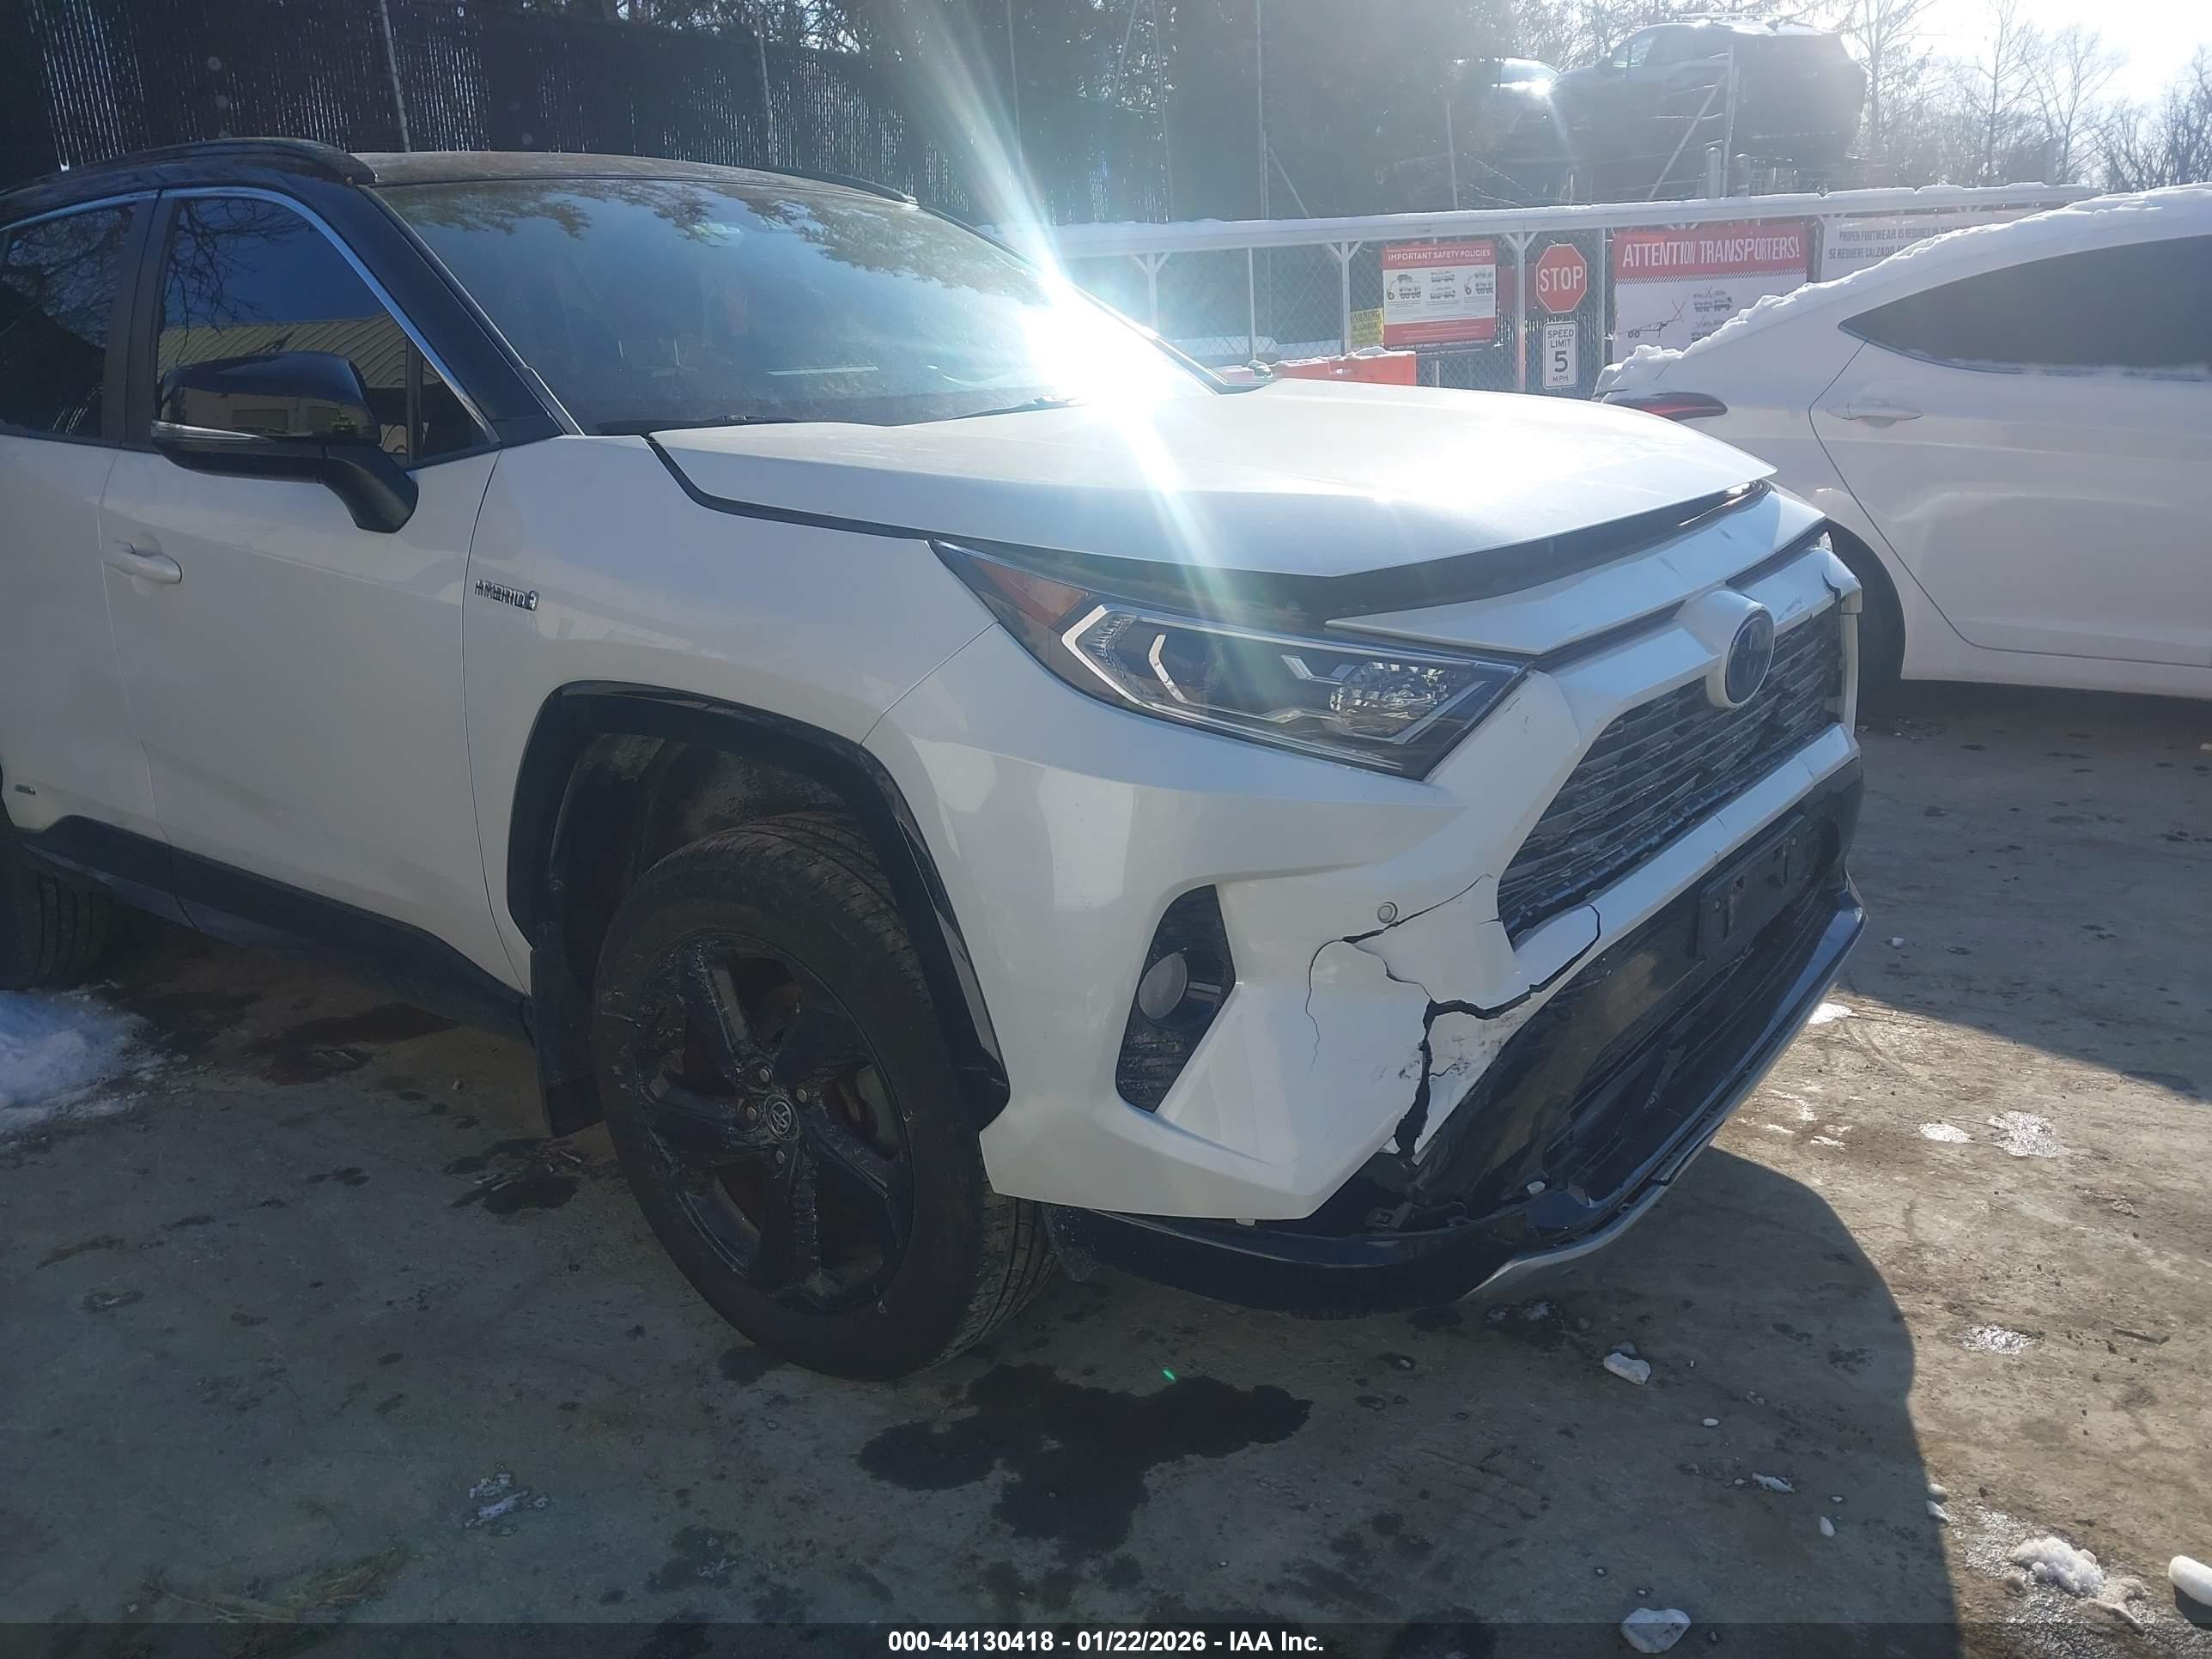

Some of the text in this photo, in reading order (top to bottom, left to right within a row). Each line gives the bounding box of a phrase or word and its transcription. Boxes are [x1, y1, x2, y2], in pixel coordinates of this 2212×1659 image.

[1861, 228, 1897, 241] FOOTWEAR
[1388, 252, 1431, 262] IMPORTANT
[1433, 250, 1459, 259] SAFETY
[1460, 248, 1491, 258] POLICIES
[1622, 235, 1800, 268] ATTENTION TRANSPORTERS!
[1540, 265, 1583, 293] STOP
[1547, 329, 1574, 338] SPEED
[1550, 338, 1571, 349] LIMIT
[1554, 349, 1569, 373] 5
[1553, 374, 1569, 383] MPH
[474, 580, 526, 606] HYBRID
